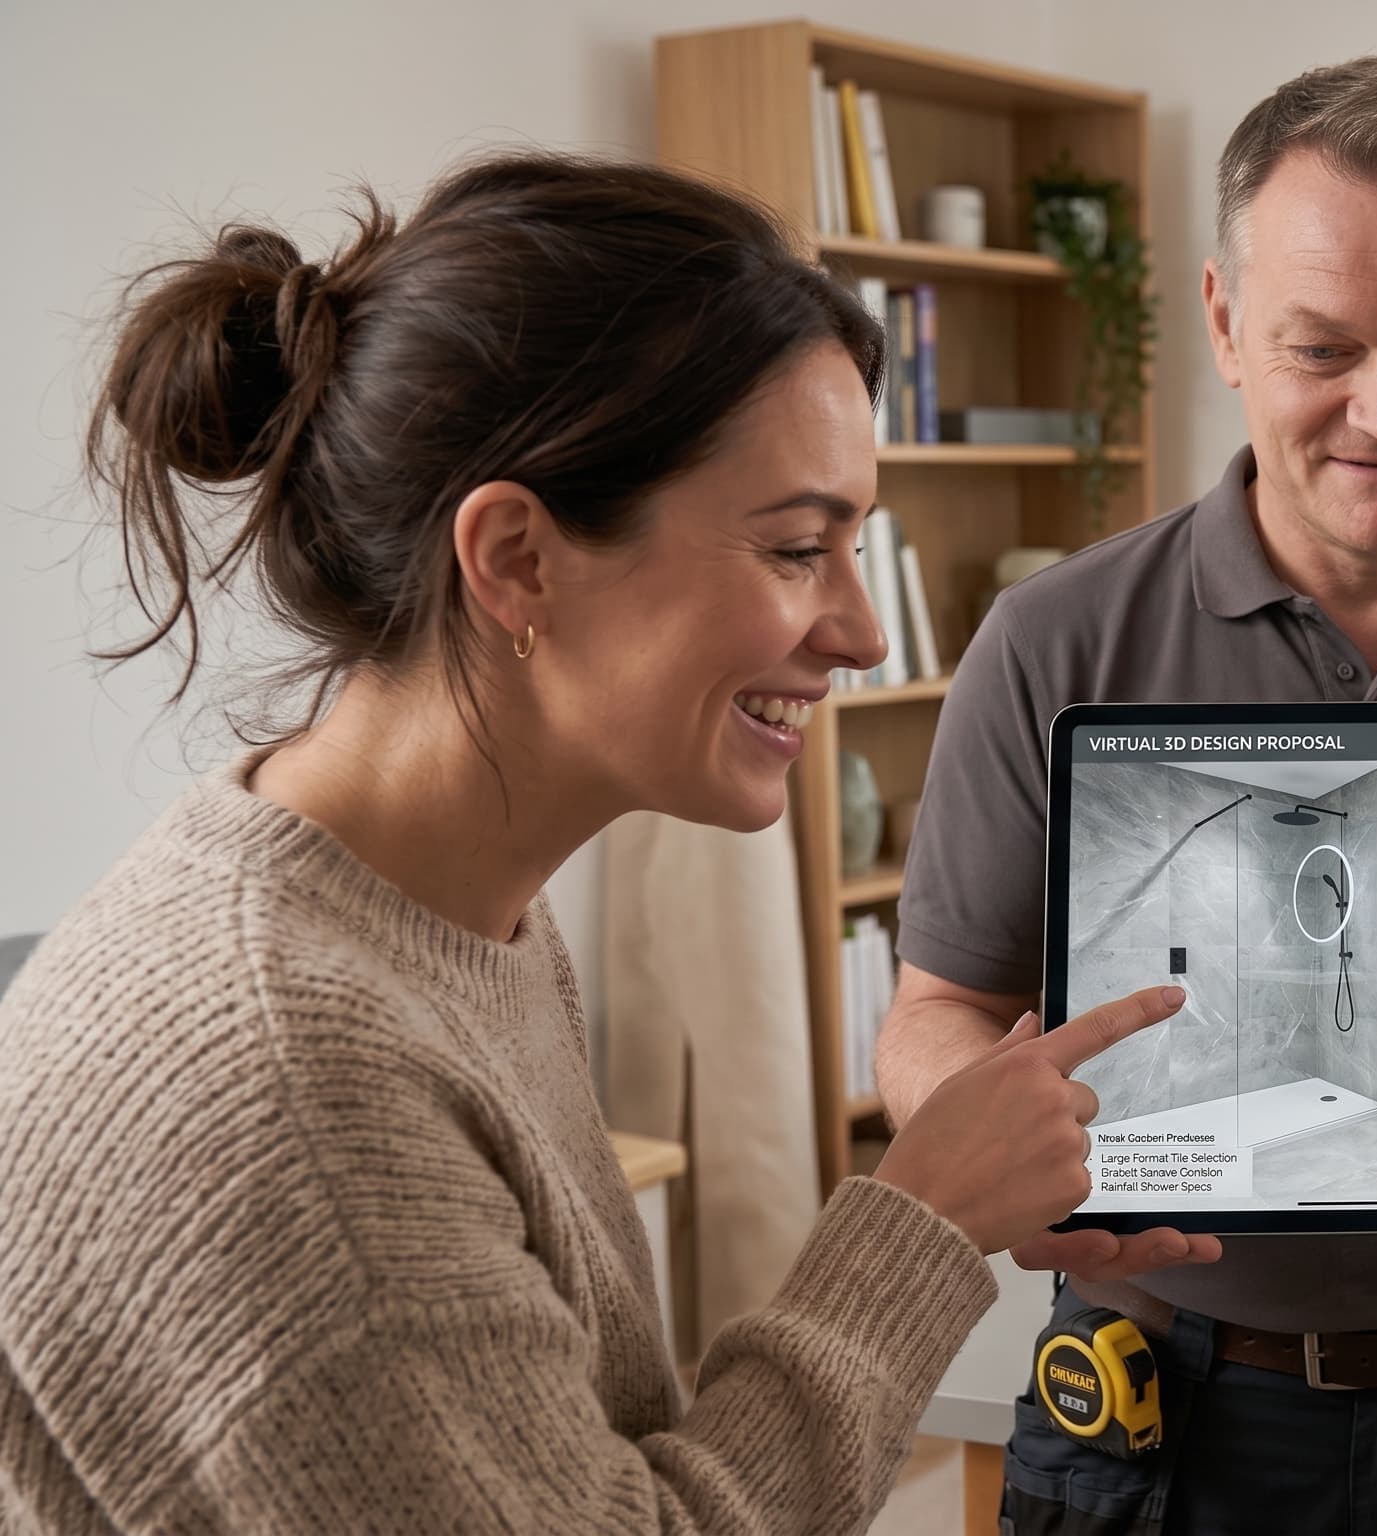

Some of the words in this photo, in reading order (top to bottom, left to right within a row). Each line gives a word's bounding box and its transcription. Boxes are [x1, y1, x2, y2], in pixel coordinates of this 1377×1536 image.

[1089, 737, 1160, 751] VIRTUAL
[1164, 737, 1187, 751] 3D
[1191, 736, 1252, 750] DESIGN
[1257, 736, 1346, 750] PROPOSAL
[1101, 1153, 1130, 1166] Large
[1132, 1153, 1169, 1164] Format
[1170, 1153, 1189, 1164] Tile
[1191, 1153, 1238, 1164] Selection
[1101, 1181, 1139, 1192] Rainfall
[1140, 1181, 1179, 1192] Shower
[1180, 1181, 1213, 1194] Specs
